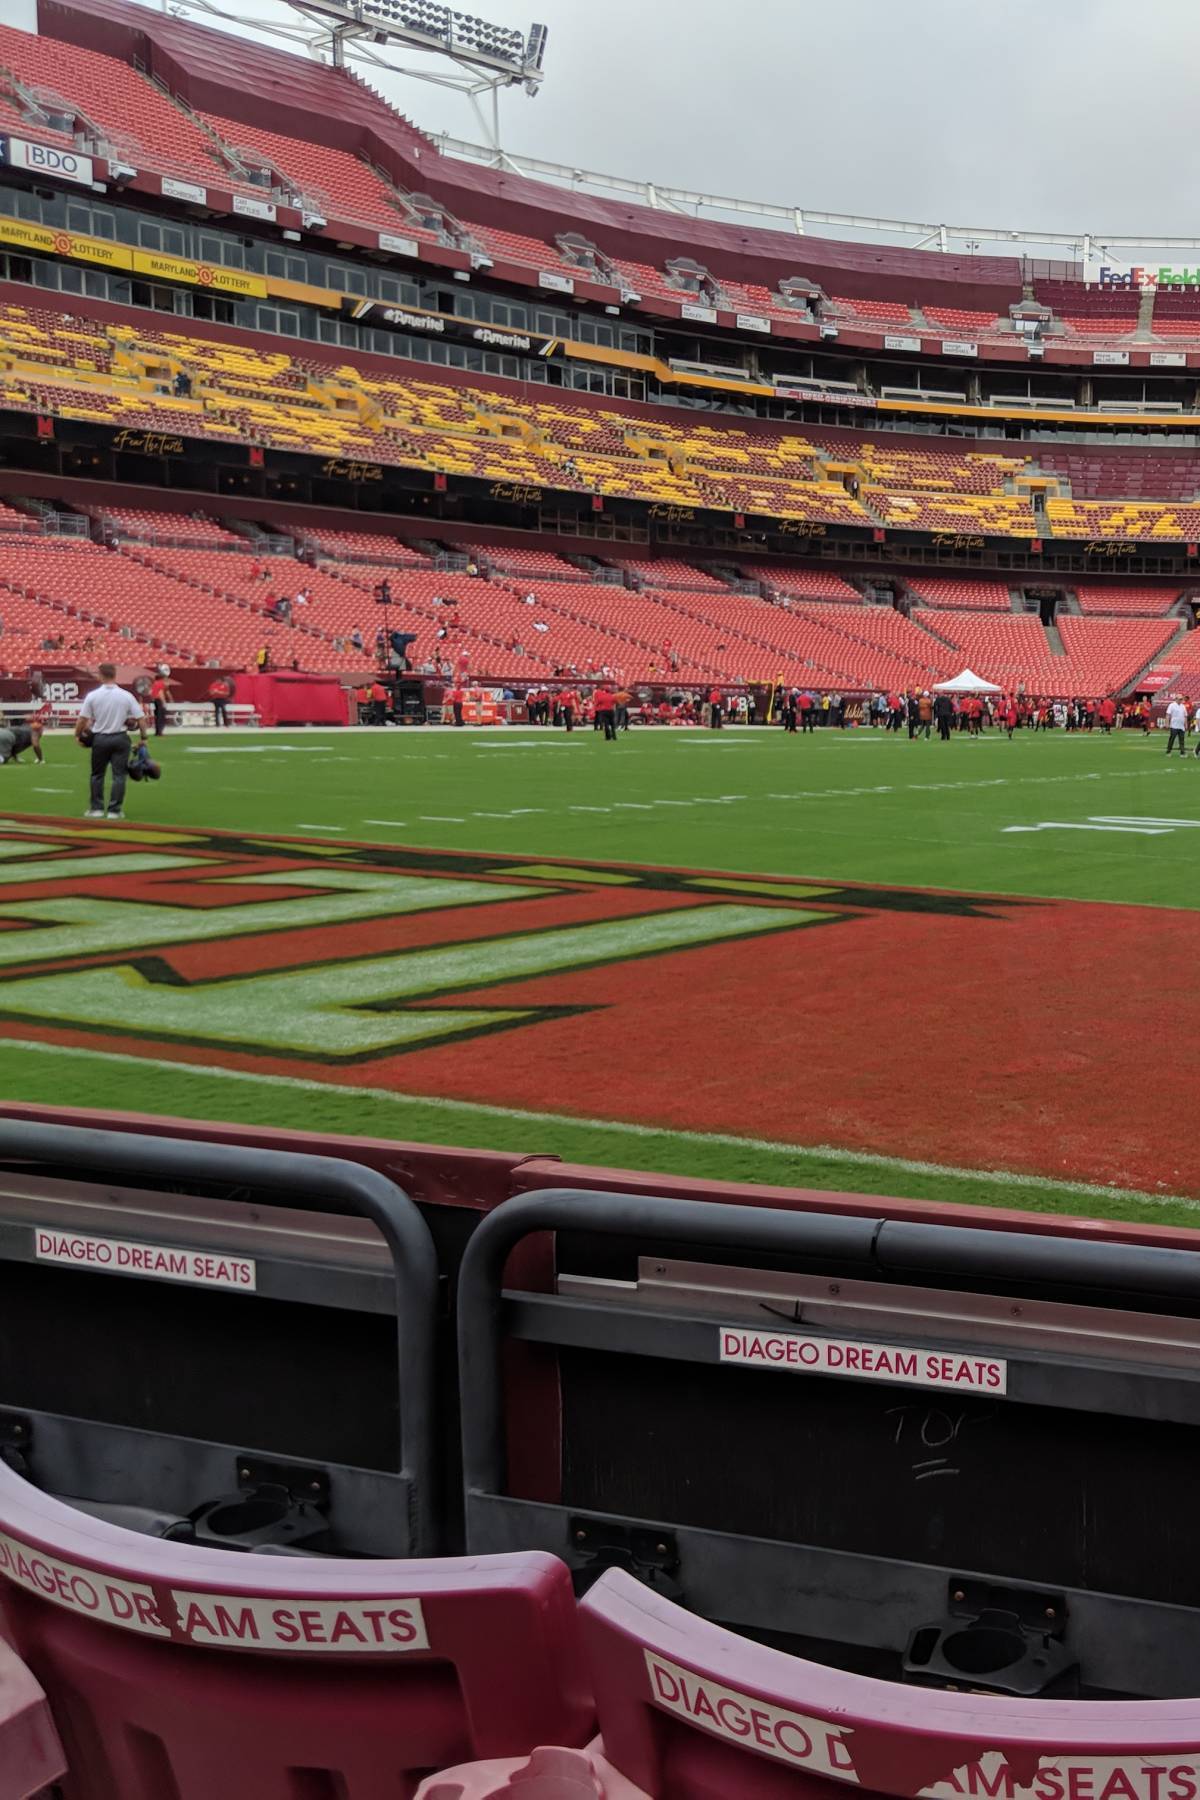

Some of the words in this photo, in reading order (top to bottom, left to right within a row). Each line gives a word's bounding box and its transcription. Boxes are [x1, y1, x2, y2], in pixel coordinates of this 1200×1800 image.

[32, 146, 77, 173] BDO
[1, 226, 52, 246] MARYLAND
[74, 243, 113, 259] LOTTERY
[151, 261, 196, 277] MARYLAND
[215, 275, 251, 289] LOTTERY
[39, 1234, 112, 1264] DIAGEO
[117, 1246, 187, 1275] DREAM
[193, 1257, 251, 1284] SEATS
[724, 1334, 820, 1365] DIAGEO
[827, 1344, 918, 1377] DREAM
[926, 1356, 1001, 1387] SEATS
[105, 1584, 261, 1640] DRAM
[272, 1609, 418, 1644] SEATS
[652, 1662, 813, 1758] DIAGEO
[1034, 1765, 1197, 1800] SEATS
